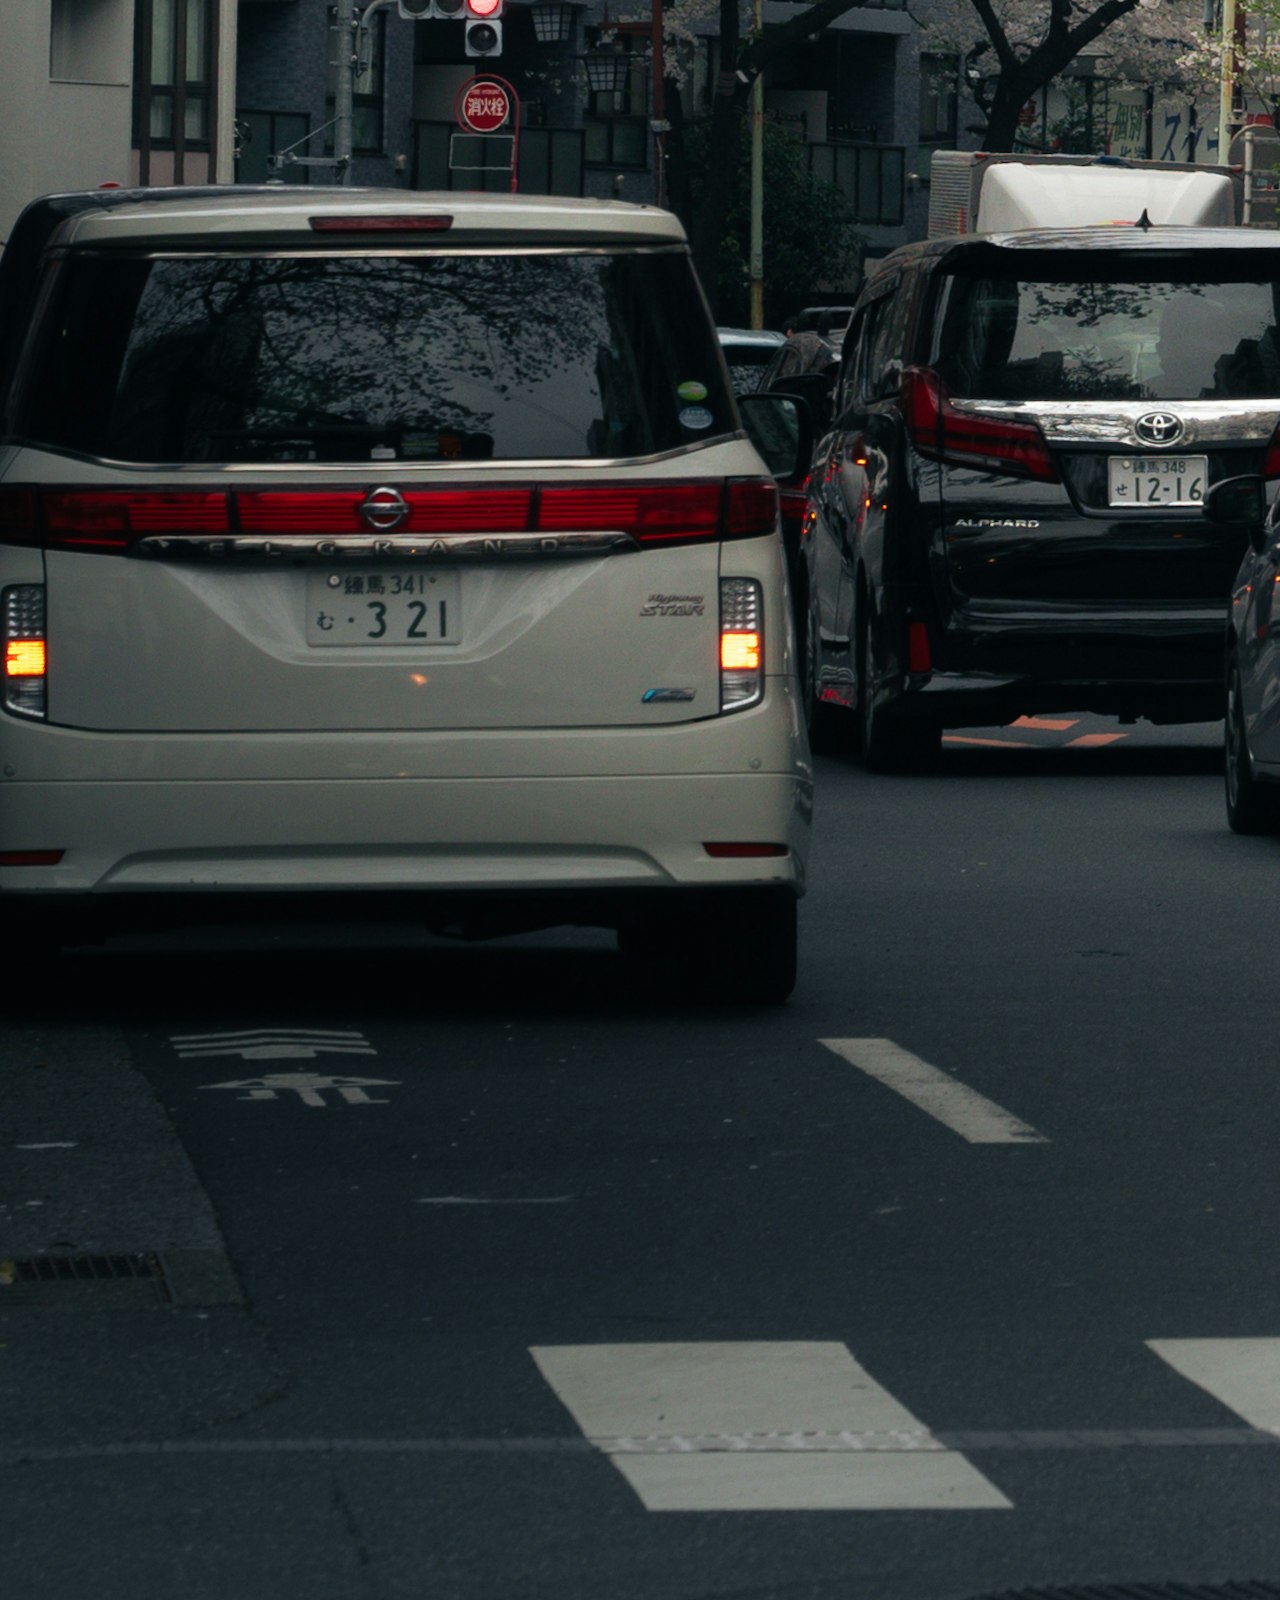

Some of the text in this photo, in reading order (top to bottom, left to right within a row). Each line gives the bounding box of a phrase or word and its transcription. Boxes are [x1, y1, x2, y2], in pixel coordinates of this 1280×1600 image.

[467, 97, 505, 116] 消火栓
[1163, 460, 1186, 474] 348
[1115, 477, 1202, 502] せ 12-16
[954, 517, 1041, 529] ALPHARD
[207, 538, 561, 555] ELGRAND
[344, 575, 424, 595] 練馬 341
[640, 603, 705, 617] STAR
[316, 611, 335, 631] む
